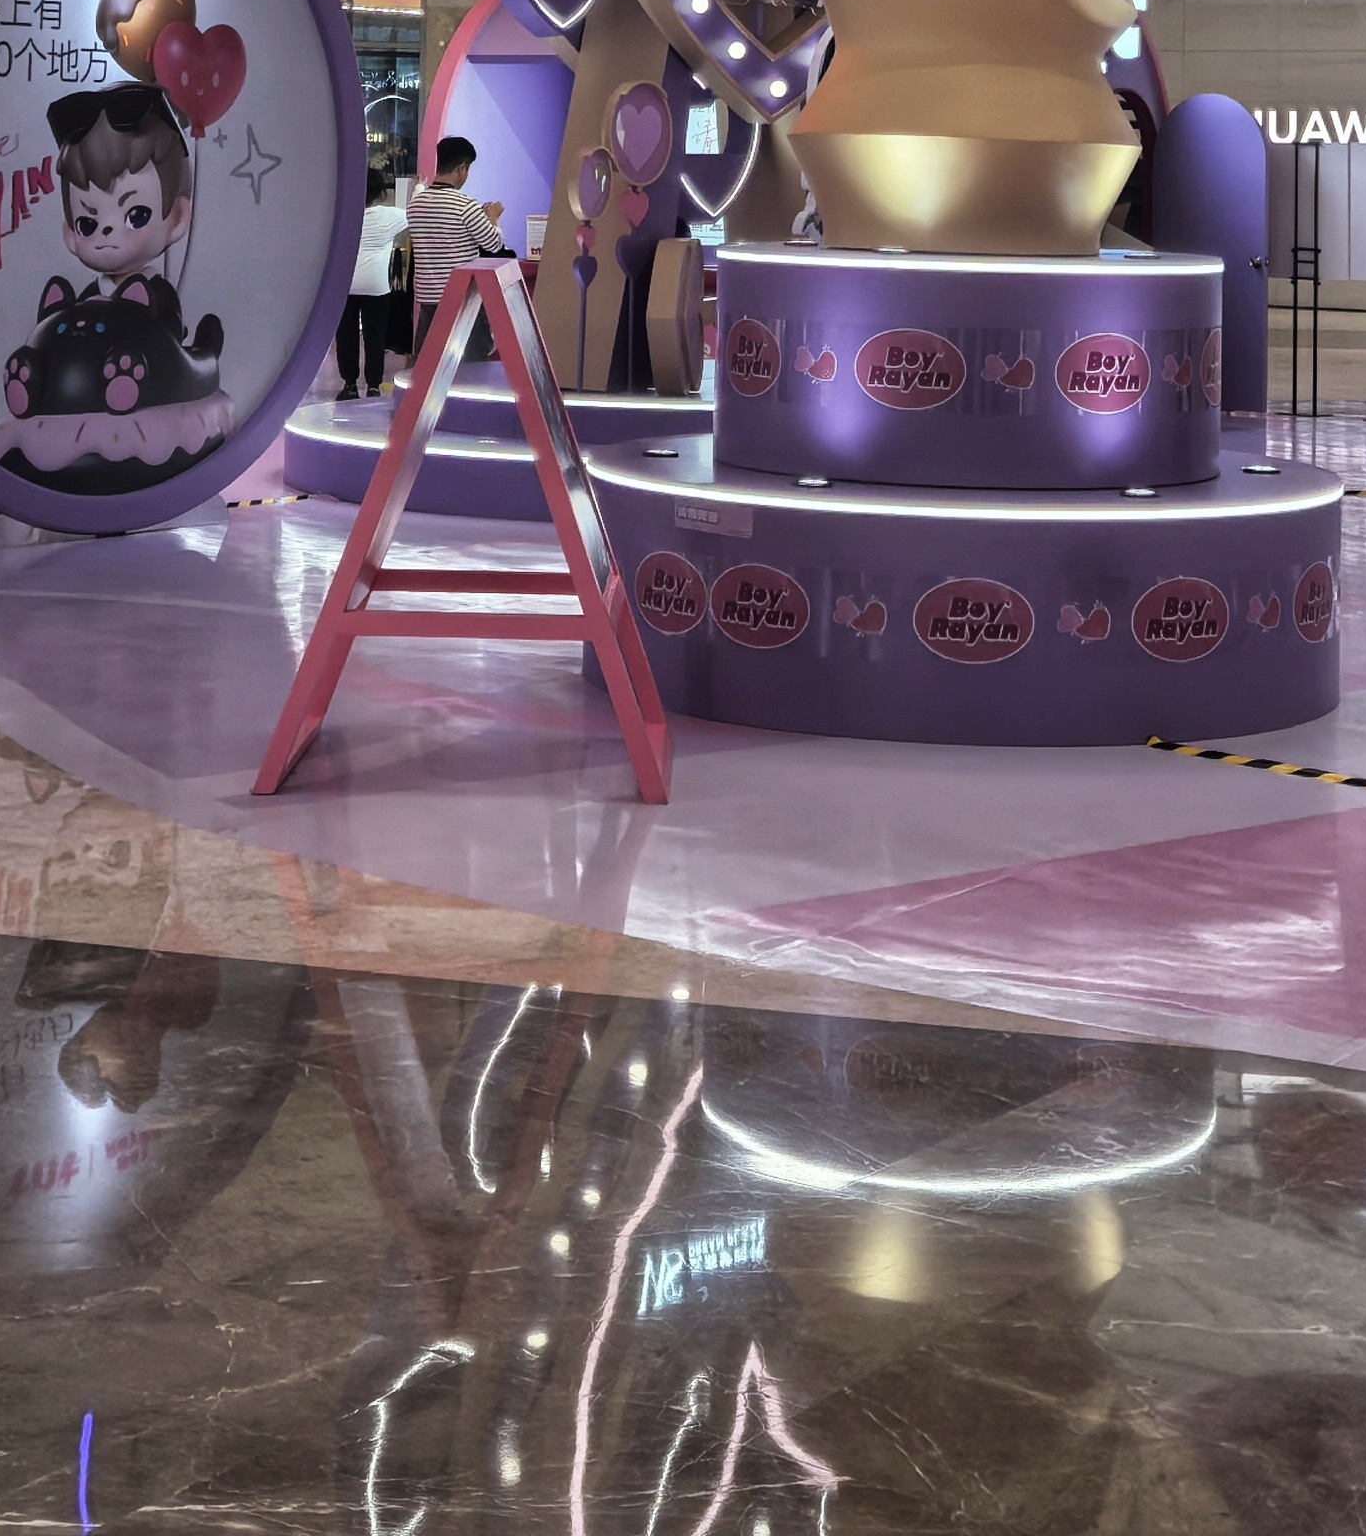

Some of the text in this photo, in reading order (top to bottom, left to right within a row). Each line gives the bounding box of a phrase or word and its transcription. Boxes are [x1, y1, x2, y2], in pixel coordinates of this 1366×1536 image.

[737, 334, 767, 357] Boy
[885, 345, 941, 372] Boy
[730, 354, 772, 380] Rayan
[1084, 351, 1133, 376] Boy
[866, 366, 952, 394] Rayan
[1068, 371, 1141, 397] Rayan
[653, 568, 689, 597] Boy
[737, 581, 785, 611] Boy
[640, 585, 697, 617] Rayan
[719, 599, 798, 631] Rayan
[947, 596, 1007, 624] Boy
[1162, 595, 1211, 621] Boy
[927, 617, 1021, 647] Rayan
[1144, 617, 1218, 645] Rayan
